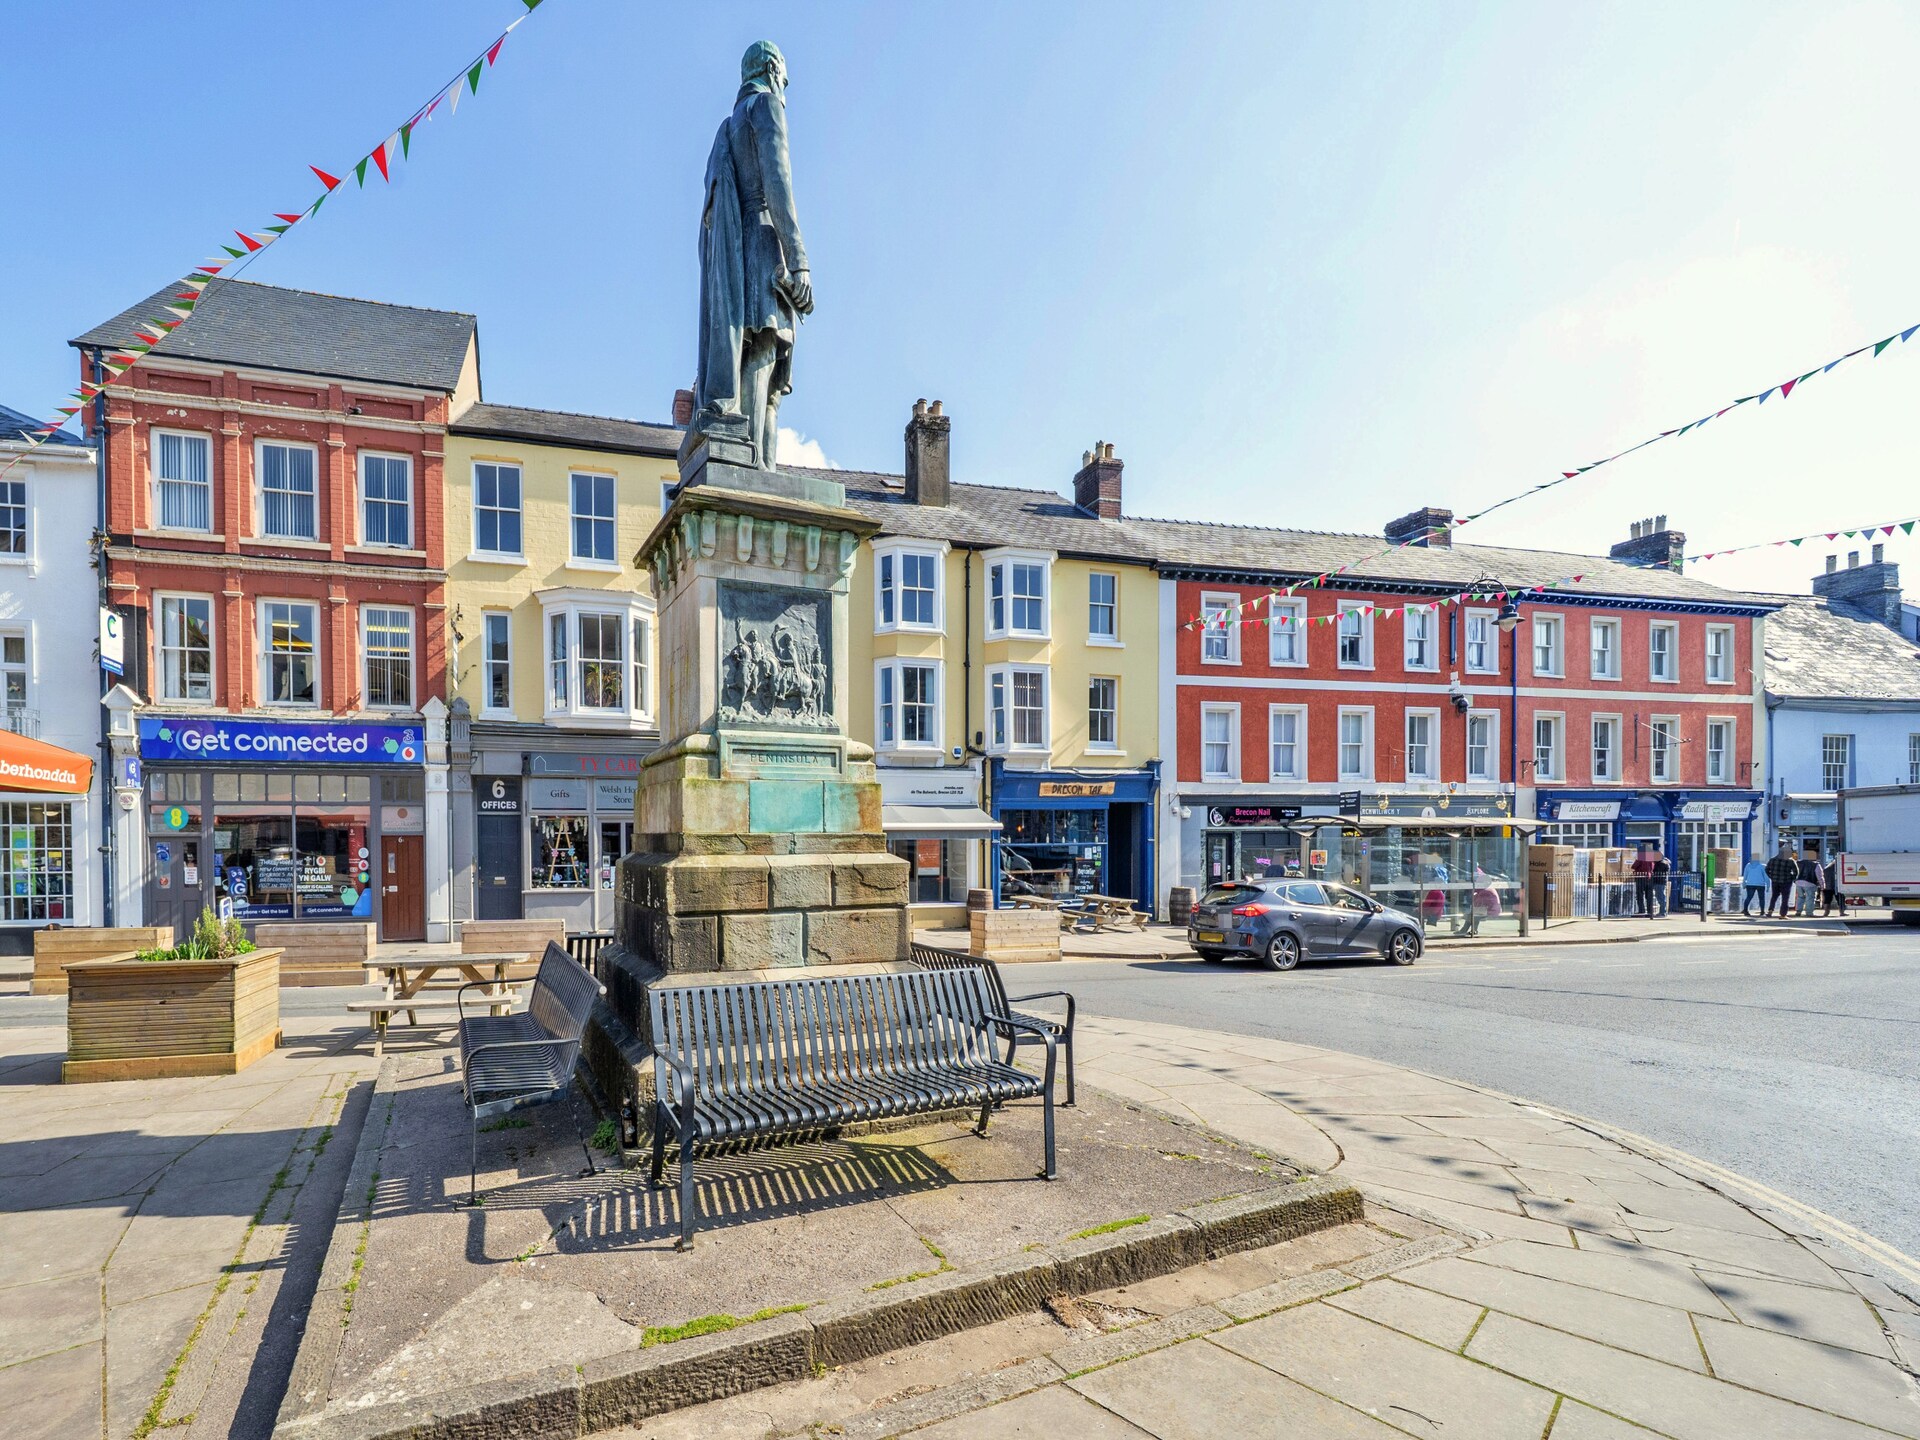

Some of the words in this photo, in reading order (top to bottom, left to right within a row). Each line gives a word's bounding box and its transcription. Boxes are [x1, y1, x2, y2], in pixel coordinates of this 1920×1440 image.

[182, 729, 230, 751] Get
[234, 732, 368, 753] connected
[577, 756, 600, 771] TY
[605, 756, 644, 772] CAR
[750, 754, 819, 764] PENINSULA
[0, 760, 77, 784] berhonddu
[491, 780, 506, 799] 6
[550, 790, 570, 798] Gifts
[600, 785, 621, 794] Welsh
[1088, 785, 1103, 795] TAP
[481, 800, 517, 810] OFFICES
[613, 796, 632, 804] Store
[1235, 808, 1257, 816] Brecon
[1258, 808, 1270, 816] Nail
[1569, 804, 1612, 814] Kitchencraft
[1723, 804, 1748, 813] evision
